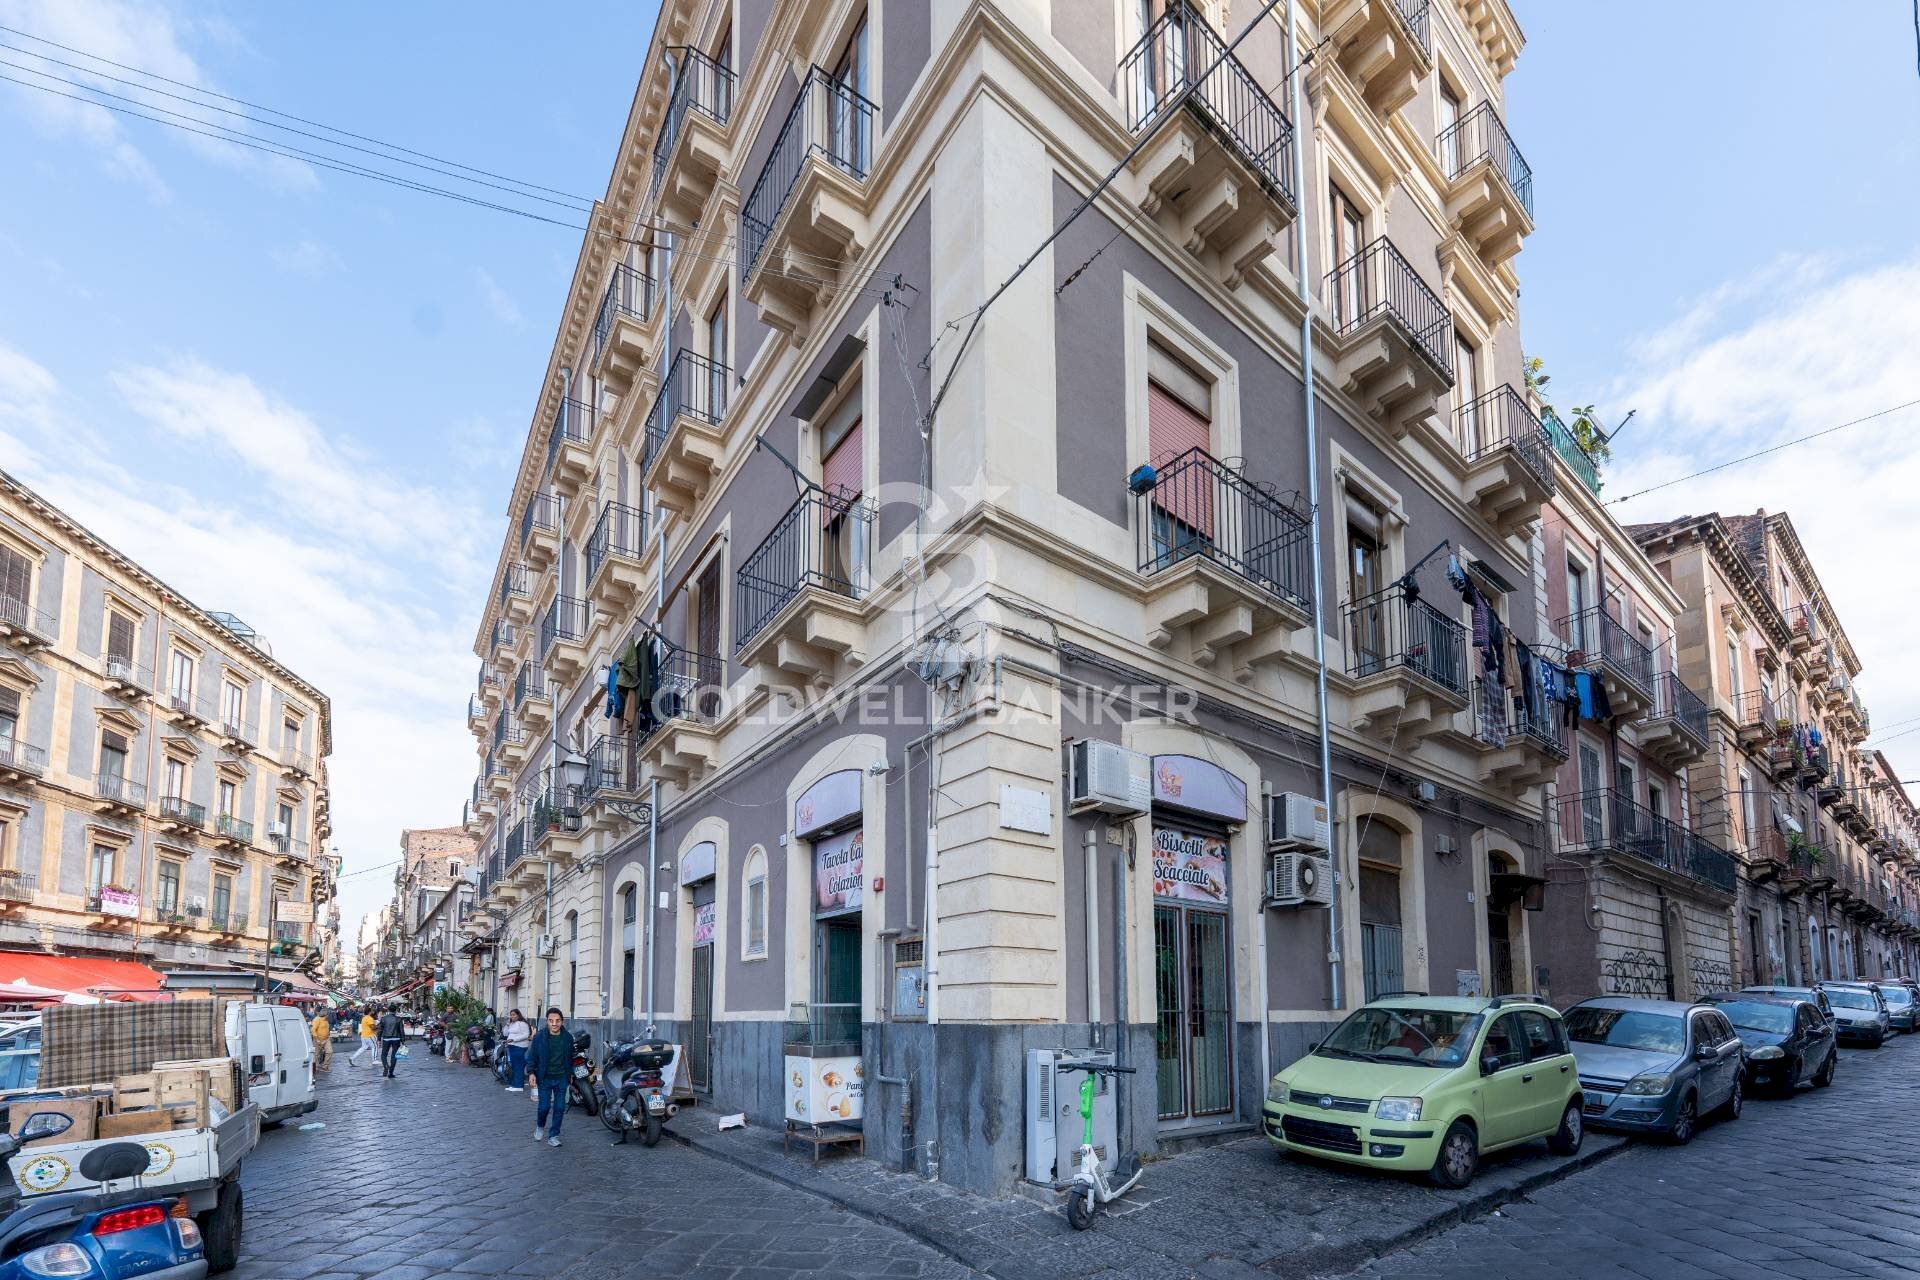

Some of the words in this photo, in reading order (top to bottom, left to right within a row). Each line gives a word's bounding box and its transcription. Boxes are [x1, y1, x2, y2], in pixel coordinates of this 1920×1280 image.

[1159, 831, 1203, 856] Biscotti
[821, 849, 848, 870] Tavola
[828, 872, 862, 894] Colazion
[1154, 859, 1209, 885] Scacciate
